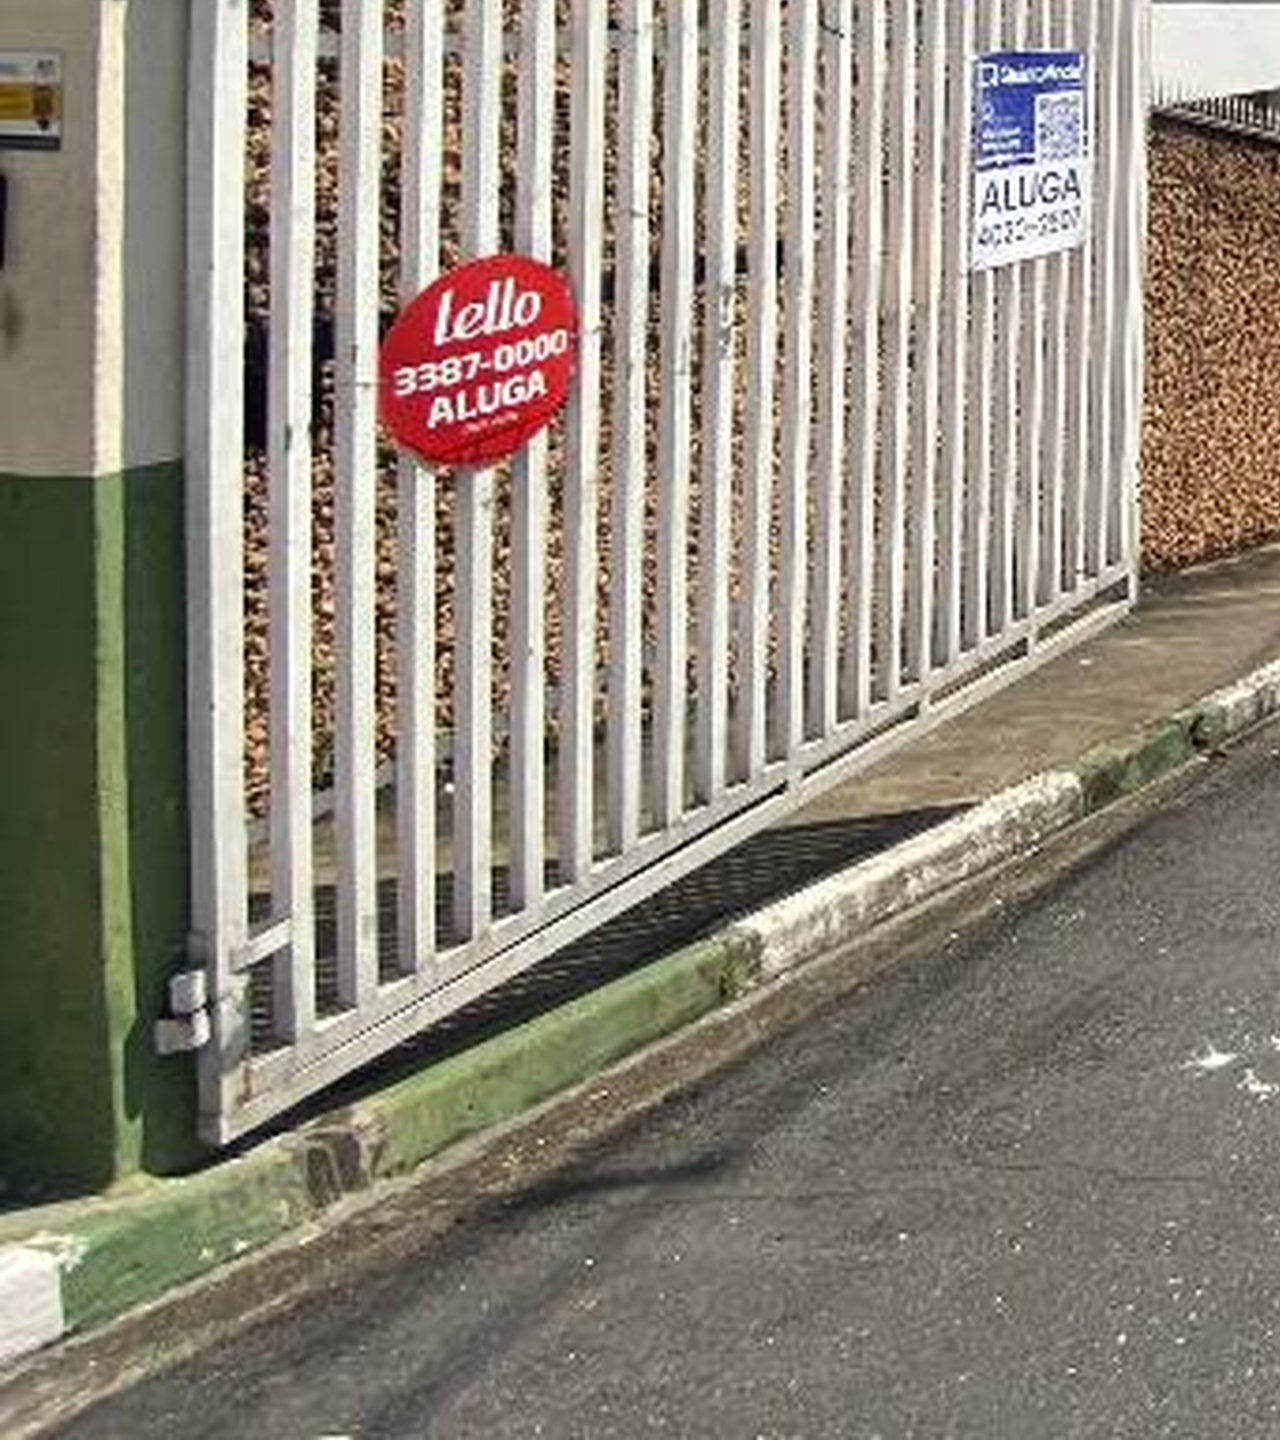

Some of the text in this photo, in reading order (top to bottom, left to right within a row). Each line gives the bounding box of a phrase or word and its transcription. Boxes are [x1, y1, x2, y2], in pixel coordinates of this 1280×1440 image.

[979, 168, 1081, 218] ALUGA
[393, 328, 569, 396] 3387-0000
[427, 368, 549, 429] ALUGA
